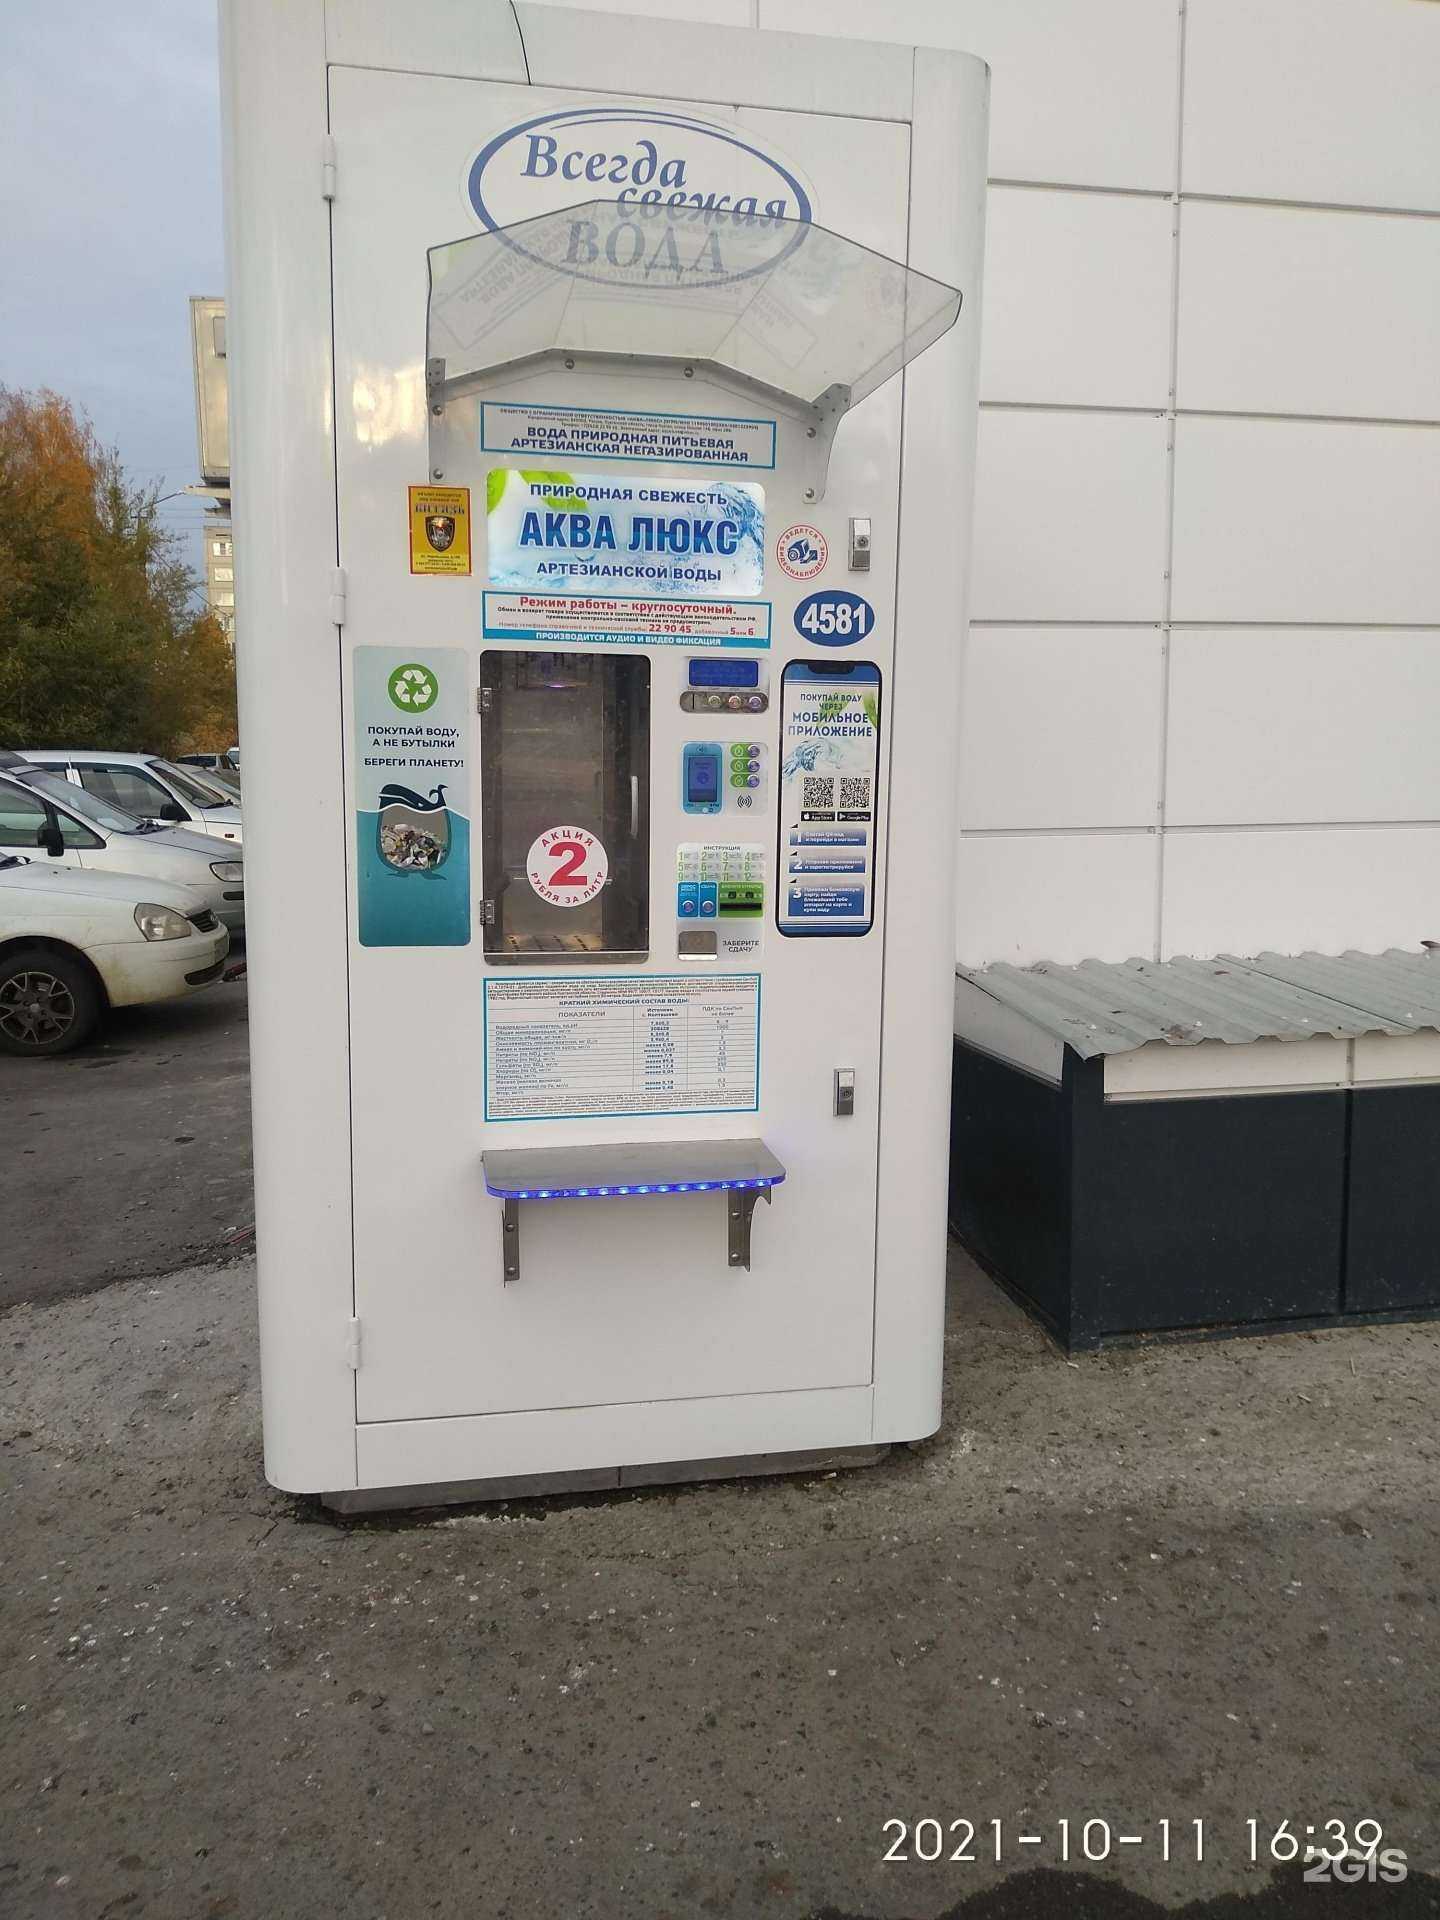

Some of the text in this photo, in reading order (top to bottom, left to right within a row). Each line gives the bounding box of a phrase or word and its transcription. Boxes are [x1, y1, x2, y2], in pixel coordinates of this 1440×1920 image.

[520, 134, 687, 188] Всегда
[616, 187, 787, 228] свежая
[560, 219, 729, 281] ВОДА
[527, 426, 568, 440] ВОДА
[571, 429, 658, 444] ПРИРОДНАЯ
[662, 435, 734, 450] ПИТЬЕВАЯ
[511, 437, 748, 462] АРТЕЗИАНСКАЯ НЕГАЗИРОВАННАЯ
[530, 484, 727, 506] ПРИРОДНАЯ СВЕЖЕСТЬ
[519, 511, 739, 555] АКВА ЛЮКС
[785, 528, 819, 540] ВЕДЕТСЯ
[779, 545, 826, 577] ВИДЕОНАБЛЮДЕНИЕ
[537, 562, 722, 582] АРТЕЗИАНСКОЙ ВОДЫ
[520, 596, 567, 608] Режим
[570, 598, 617, 611] работы
[632, 602, 737, 615] круглосуточный.
[801, 603, 866, 635] 4581
[648, 624, 662, 632] 22
[664, 625, 676, 633] 90
[680, 625, 692, 634] 45
[730, 627, 736, 635] 5
[748, 628, 754, 636] 6
[536, 631, 605, 641] ПРОИЗВОДИТСЯ
[606, 634, 637, 643] АУДИО
[645, 635, 674, 644] ВИДЕО
[675, 637, 721, 646] ФИКСАЦИЯ
[800, 692, 863, 702] ПОКУПАЙ ВОДУ
[819, 703, 843, 711] ЧЕРЕЗ
[792, 711, 869, 724] МОБИЛЬНОЕ
[368, 725, 460, 738] ПОКУПАЙ ВОДУ,
[788, 725, 872, 737] ПРИЛОЖЕНИЕ
[372, 738, 380, 746] А
[401, 739, 455, 748] БУТЫЛКИ
[364, 757, 464, 768] БЕРЕГИ ПЛАНЕТУ!
[541, 830, 594, 848] АКЦИЯ
[701, 851, 707, 860] 2
[722, 851, 729, 860] 3
[548, 841, 587, 886] 2
[678, 862, 684, 871] 5
[701, 862, 707, 871] 6
[722, 862, 728, 871] 7
[793, 858, 803, 870] 2
[744, 872, 752, 881] 12
[531, 871, 605, 904] РУБЛЯ ЗА ЛИТР
[793, 887, 802, 898] 3
[592, 998, 640, 1006] ХИМИЧЕСКИЙ
